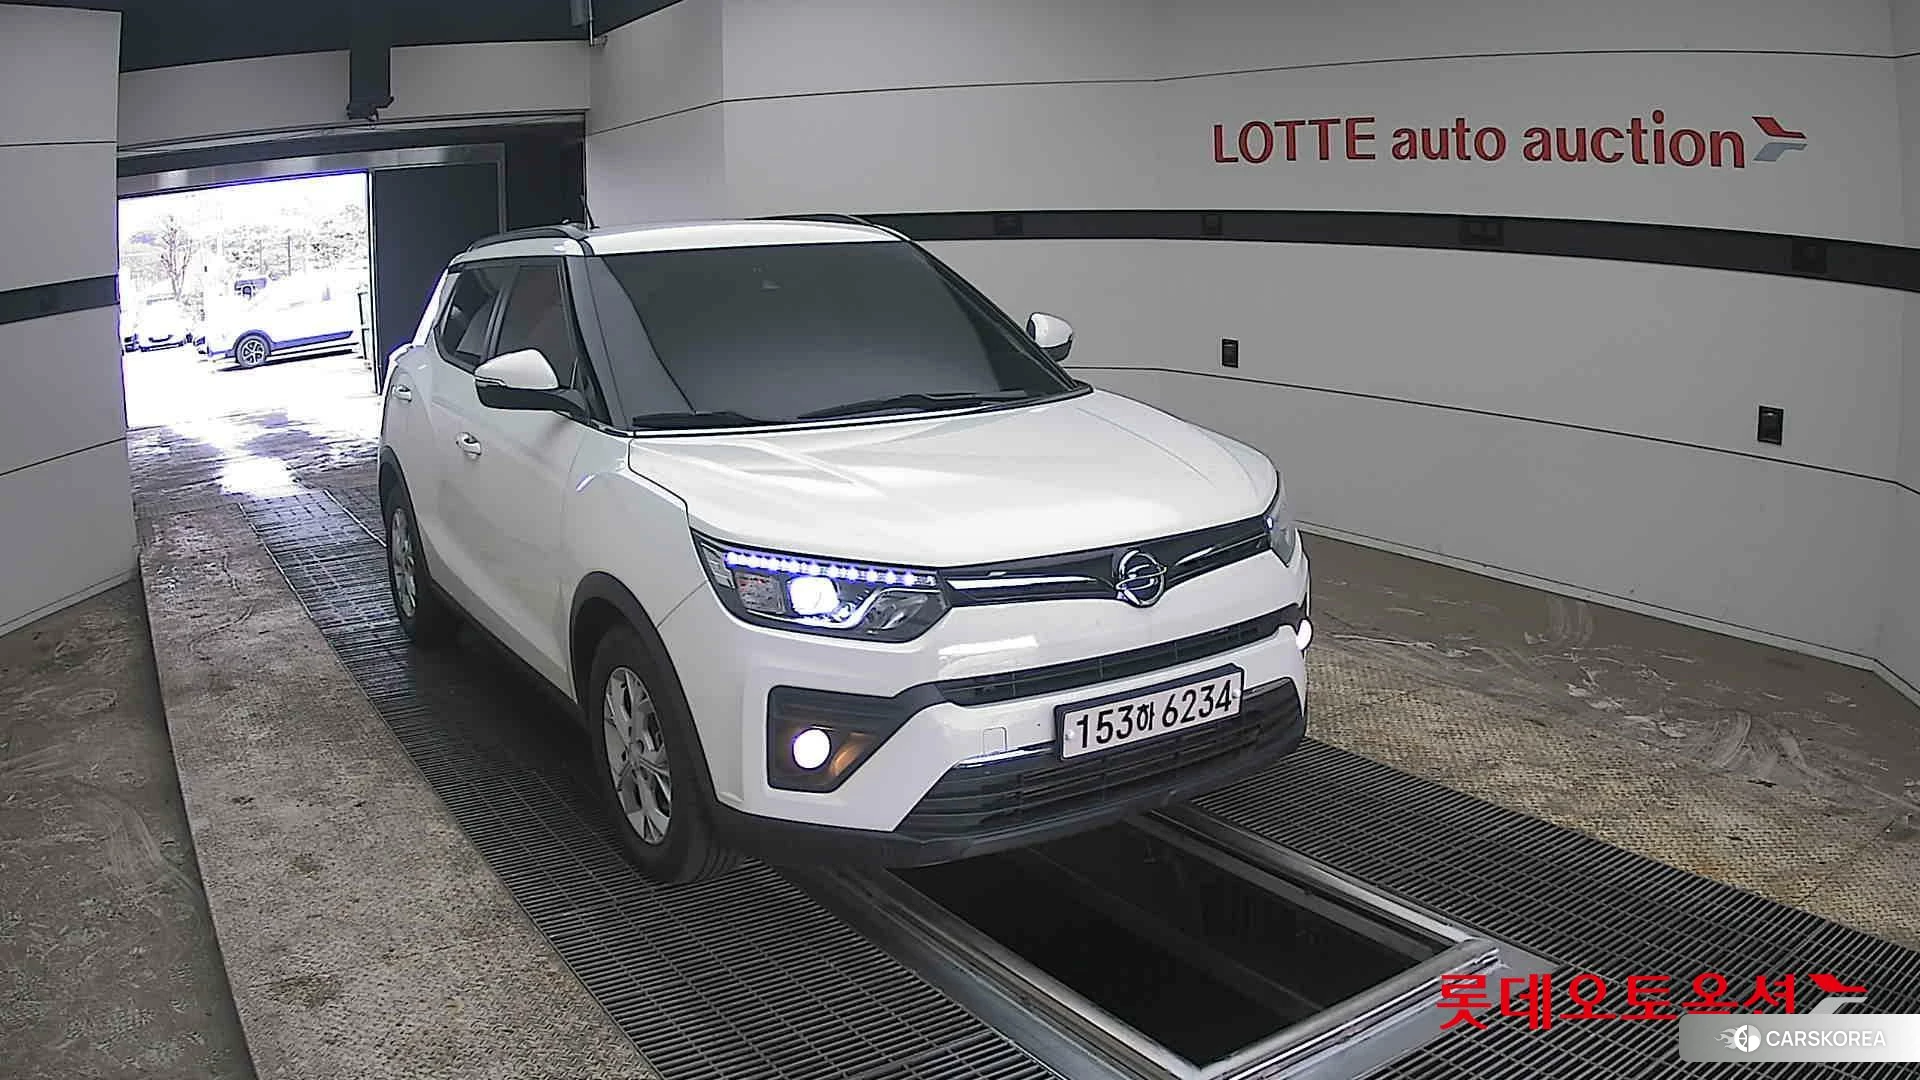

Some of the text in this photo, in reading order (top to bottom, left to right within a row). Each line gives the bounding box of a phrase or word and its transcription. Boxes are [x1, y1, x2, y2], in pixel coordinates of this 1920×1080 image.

[1213, 110, 1746, 169] LOTTE auto auction
